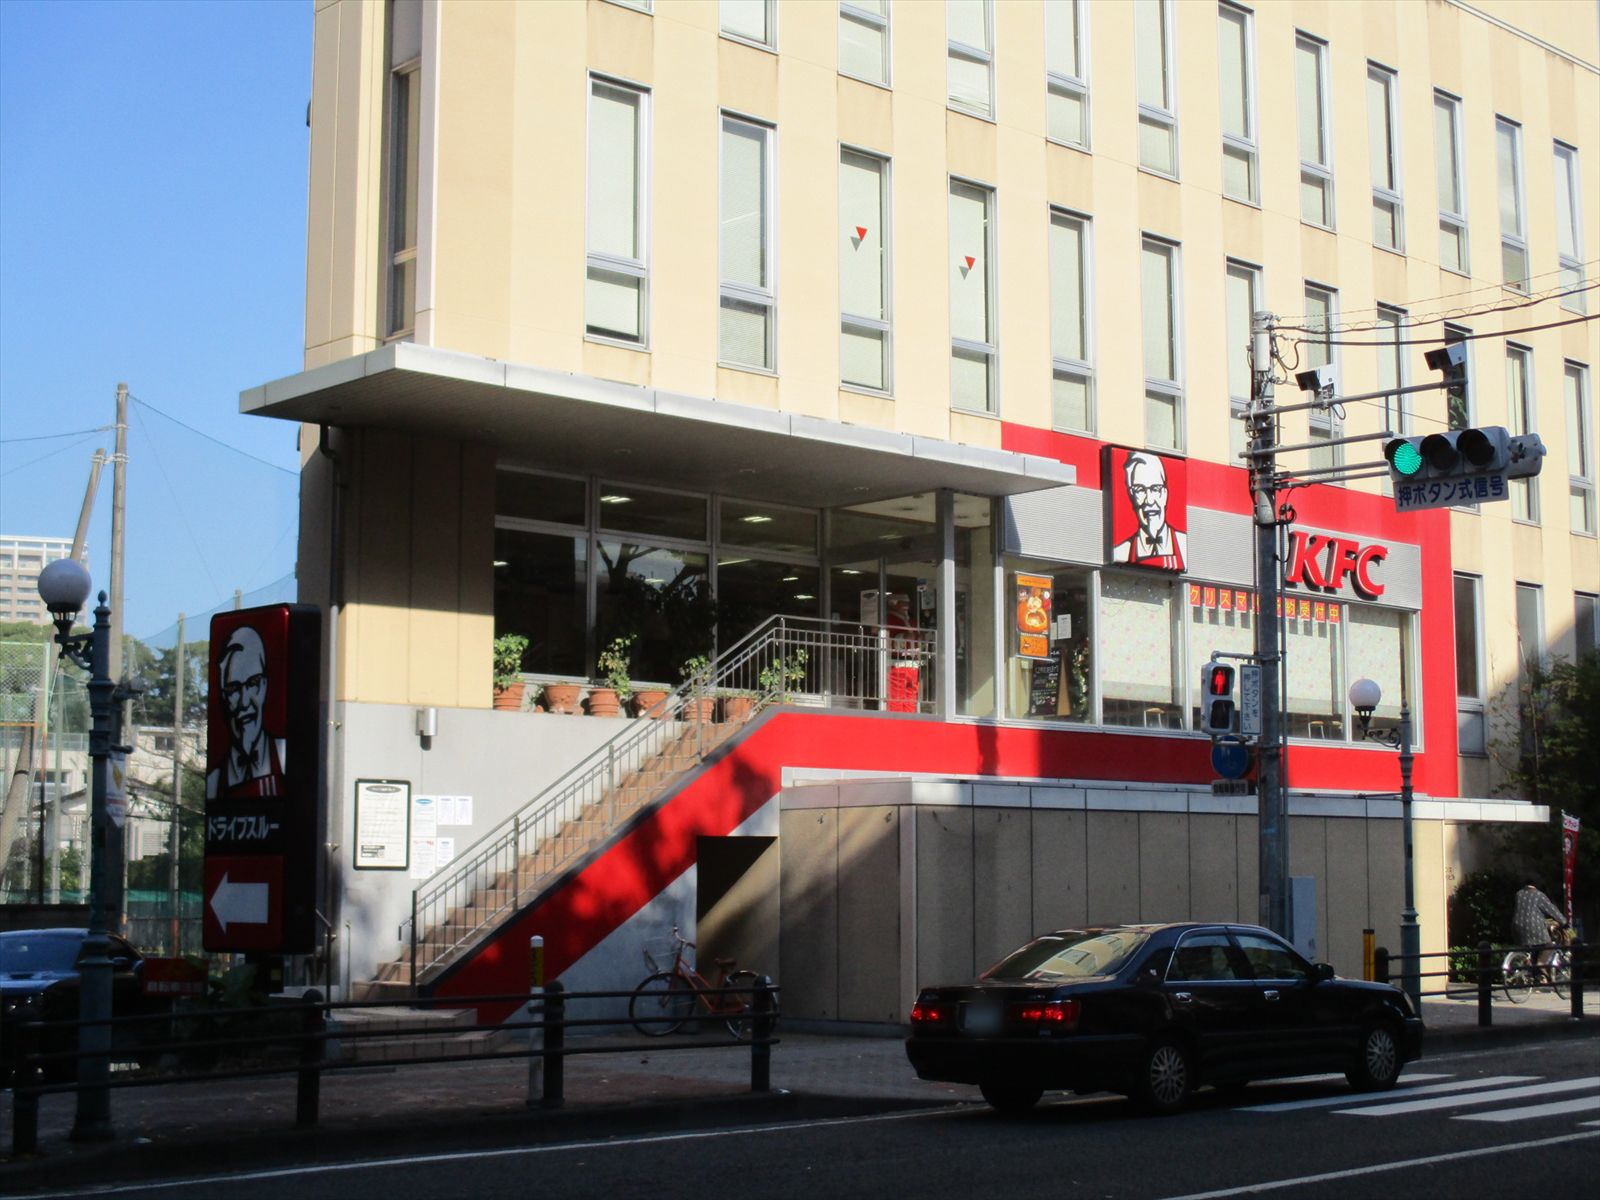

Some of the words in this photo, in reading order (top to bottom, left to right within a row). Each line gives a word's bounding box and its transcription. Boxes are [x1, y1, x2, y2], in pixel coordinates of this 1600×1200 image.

[1398, 475, 1504, 507] 押ボタン式信号
[1286, 531, 1388, 596] KFC
[1190, 587, 1338, 617] クリスマ約受付中
[208, 816, 280, 841] ドライブスルー
